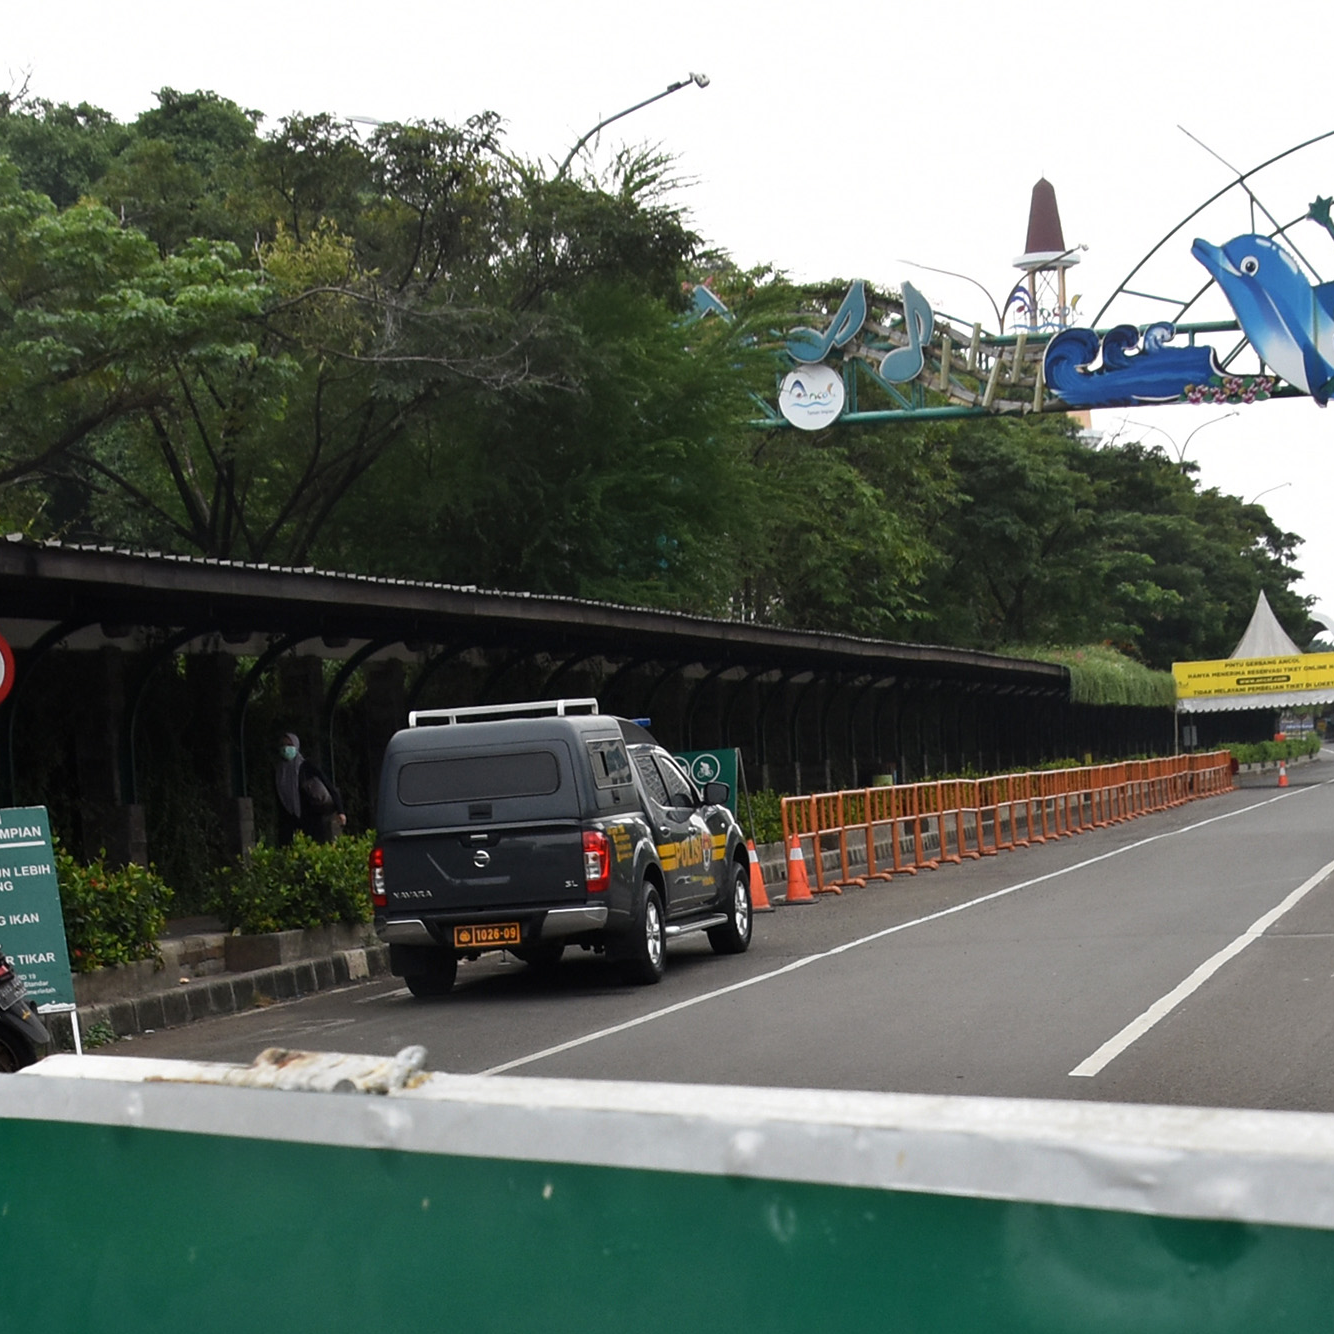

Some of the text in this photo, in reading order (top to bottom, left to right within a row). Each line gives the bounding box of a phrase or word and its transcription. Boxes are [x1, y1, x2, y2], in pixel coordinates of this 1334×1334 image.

[14, 864, 51, 877] LEBIH
[9, 912, 40, 926] IKAN
[17, 952, 56, 965] TIKAR
